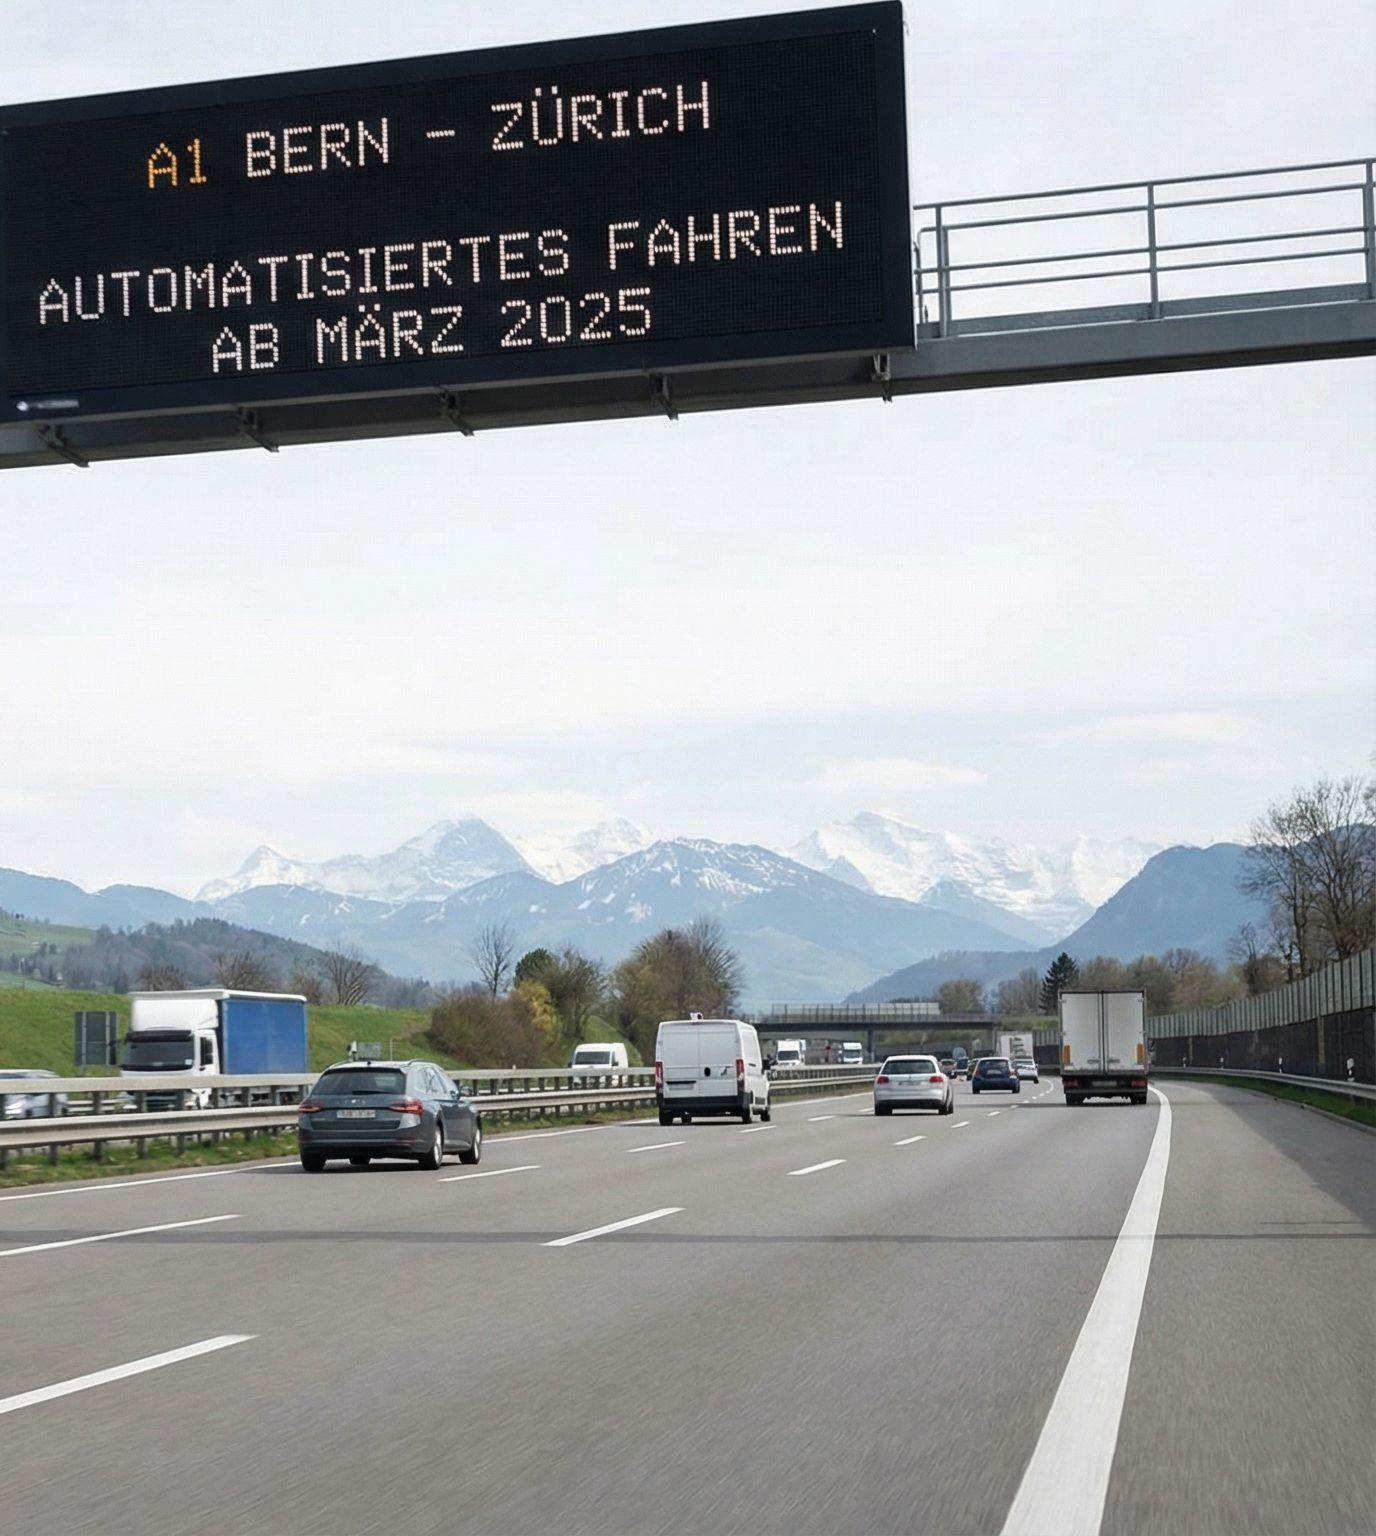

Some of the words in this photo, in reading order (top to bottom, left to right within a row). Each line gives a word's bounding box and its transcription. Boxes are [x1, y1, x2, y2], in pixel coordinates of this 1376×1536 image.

[148, 139, 207, 188] A1
[246, 118, 388, 177] BERN
[491, 82, 710, 150] ZÜRICH
[39, 230, 570, 325] AUTOMATISIERTES
[608, 202, 843, 269] FAHREN
[212, 323, 279, 373] AB
[315, 304, 464, 363] MÄRZ
[500, 288, 651, 347] 2025
